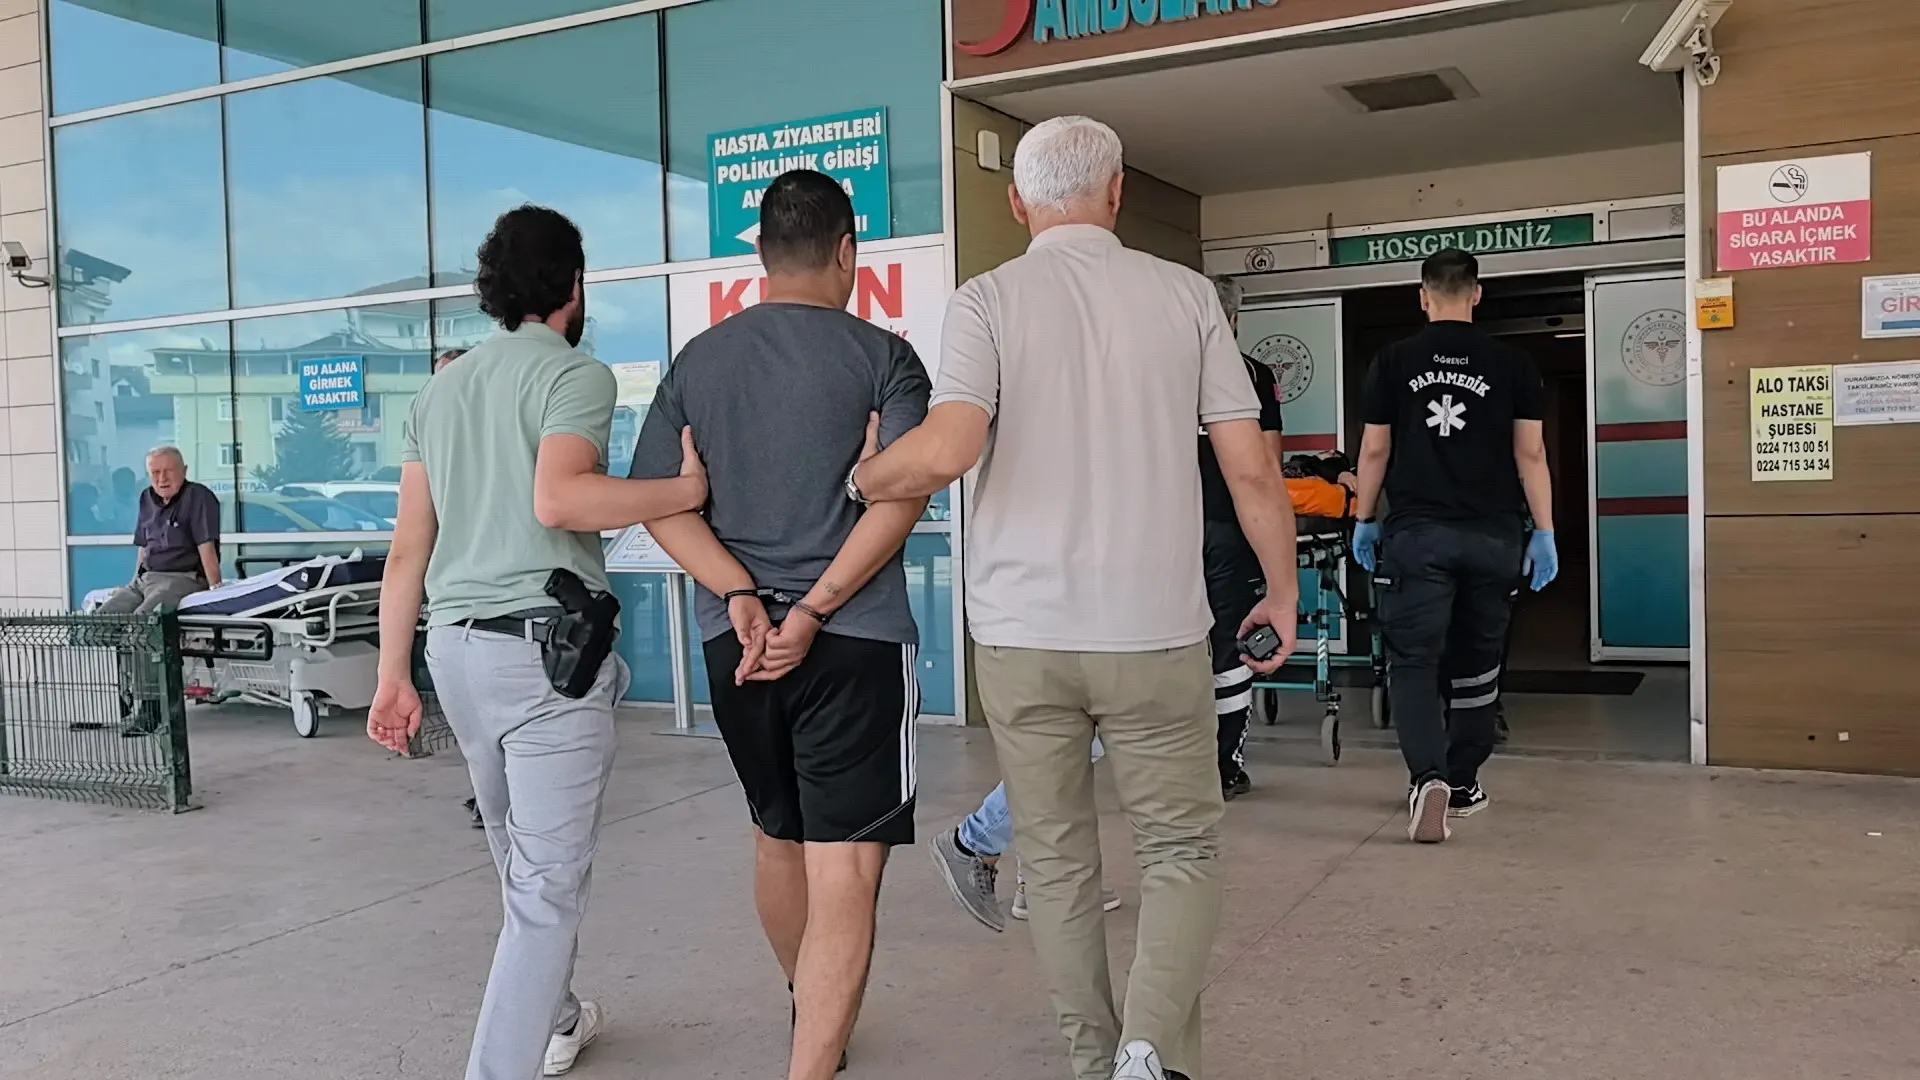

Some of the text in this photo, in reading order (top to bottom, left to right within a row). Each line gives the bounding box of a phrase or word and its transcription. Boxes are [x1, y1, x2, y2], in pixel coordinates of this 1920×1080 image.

[715, 111, 882, 157] HASTA ZİYARETLERİ
[717, 139, 880, 185] POLİKLİNİK GİRİŞİ
[1743, 205, 1845, 228] BU ALANDA
[1729, 223, 1858, 249] SİGARA İÇMEK
[1749, 246, 1836, 267] YASAKTIR
[303, 361, 358, 377] BU ALANA
[309, 375, 353, 391] GİRMEK
[1408, 370, 1491, 398] PARAMEDİK
[1756, 377, 1784, 394] ALO
[304, 390, 359, 406] YASAKTIR
[1761, 402, 1824, 418] HASTANE
[1756, 440, 1829, 454] 0224 713 00 51
[1757, 458, 1830, 472] 0224 715 34 34
